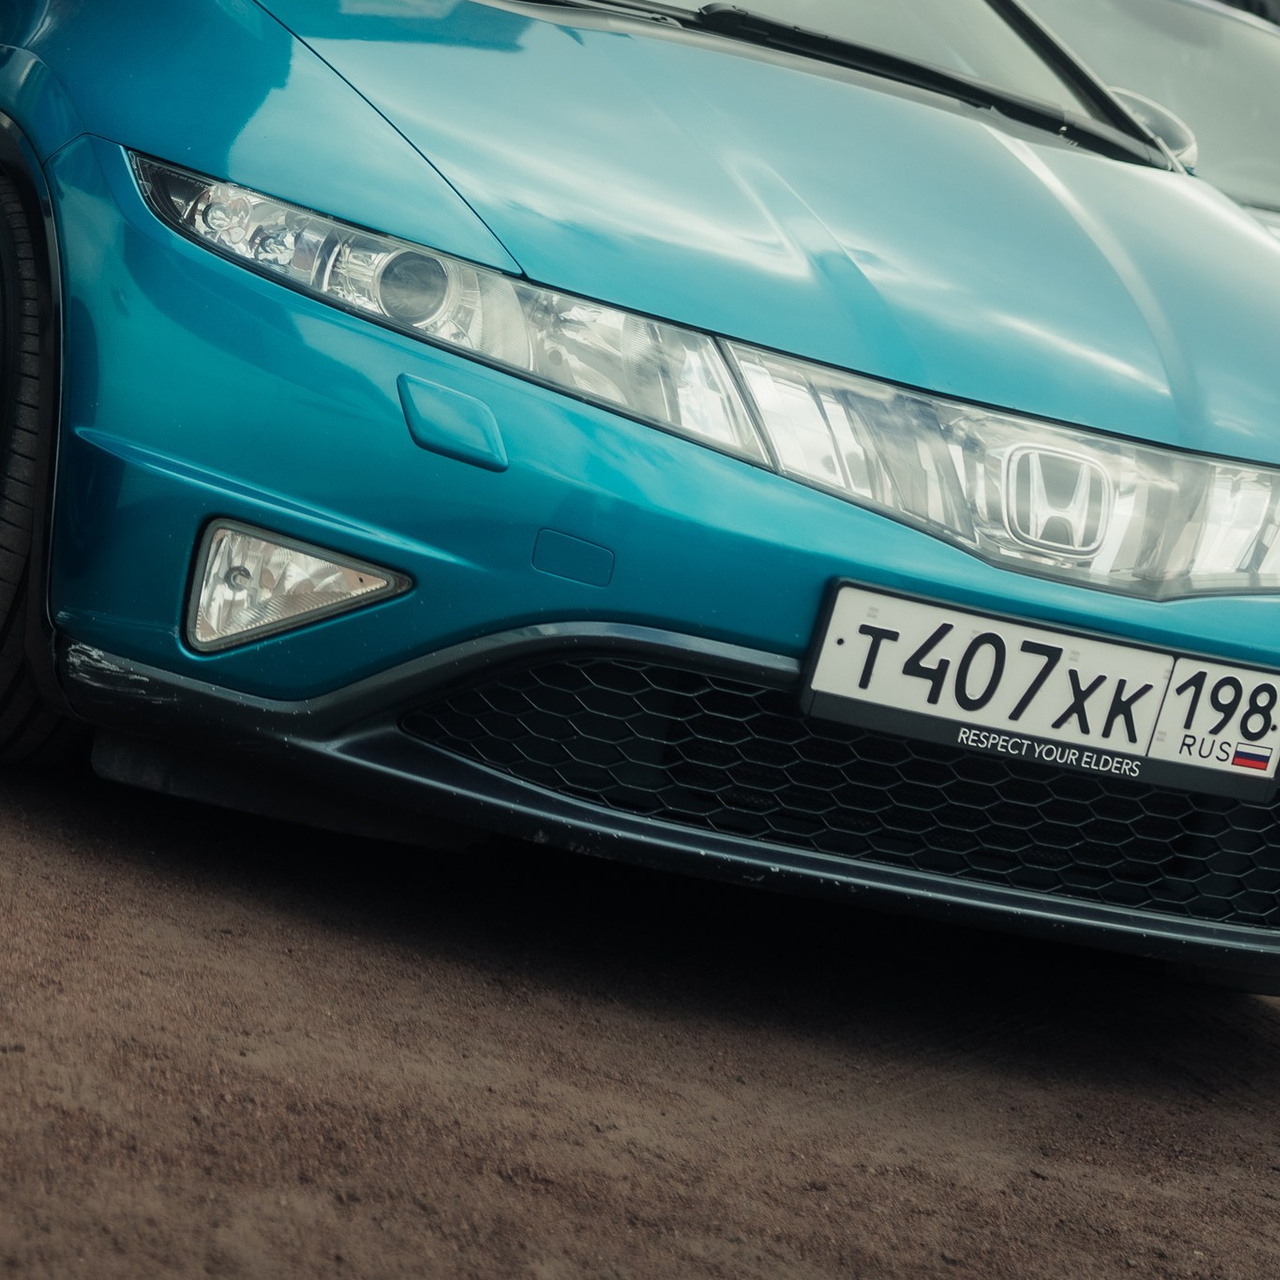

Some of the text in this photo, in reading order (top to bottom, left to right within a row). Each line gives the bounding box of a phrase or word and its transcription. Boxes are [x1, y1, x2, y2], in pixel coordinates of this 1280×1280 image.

[1175, 670, 1278, 742] 198
[957, 727, 1142, 778] RESPECT YOUR ELDERS
[1179, 733, 1232, 762] RUS
